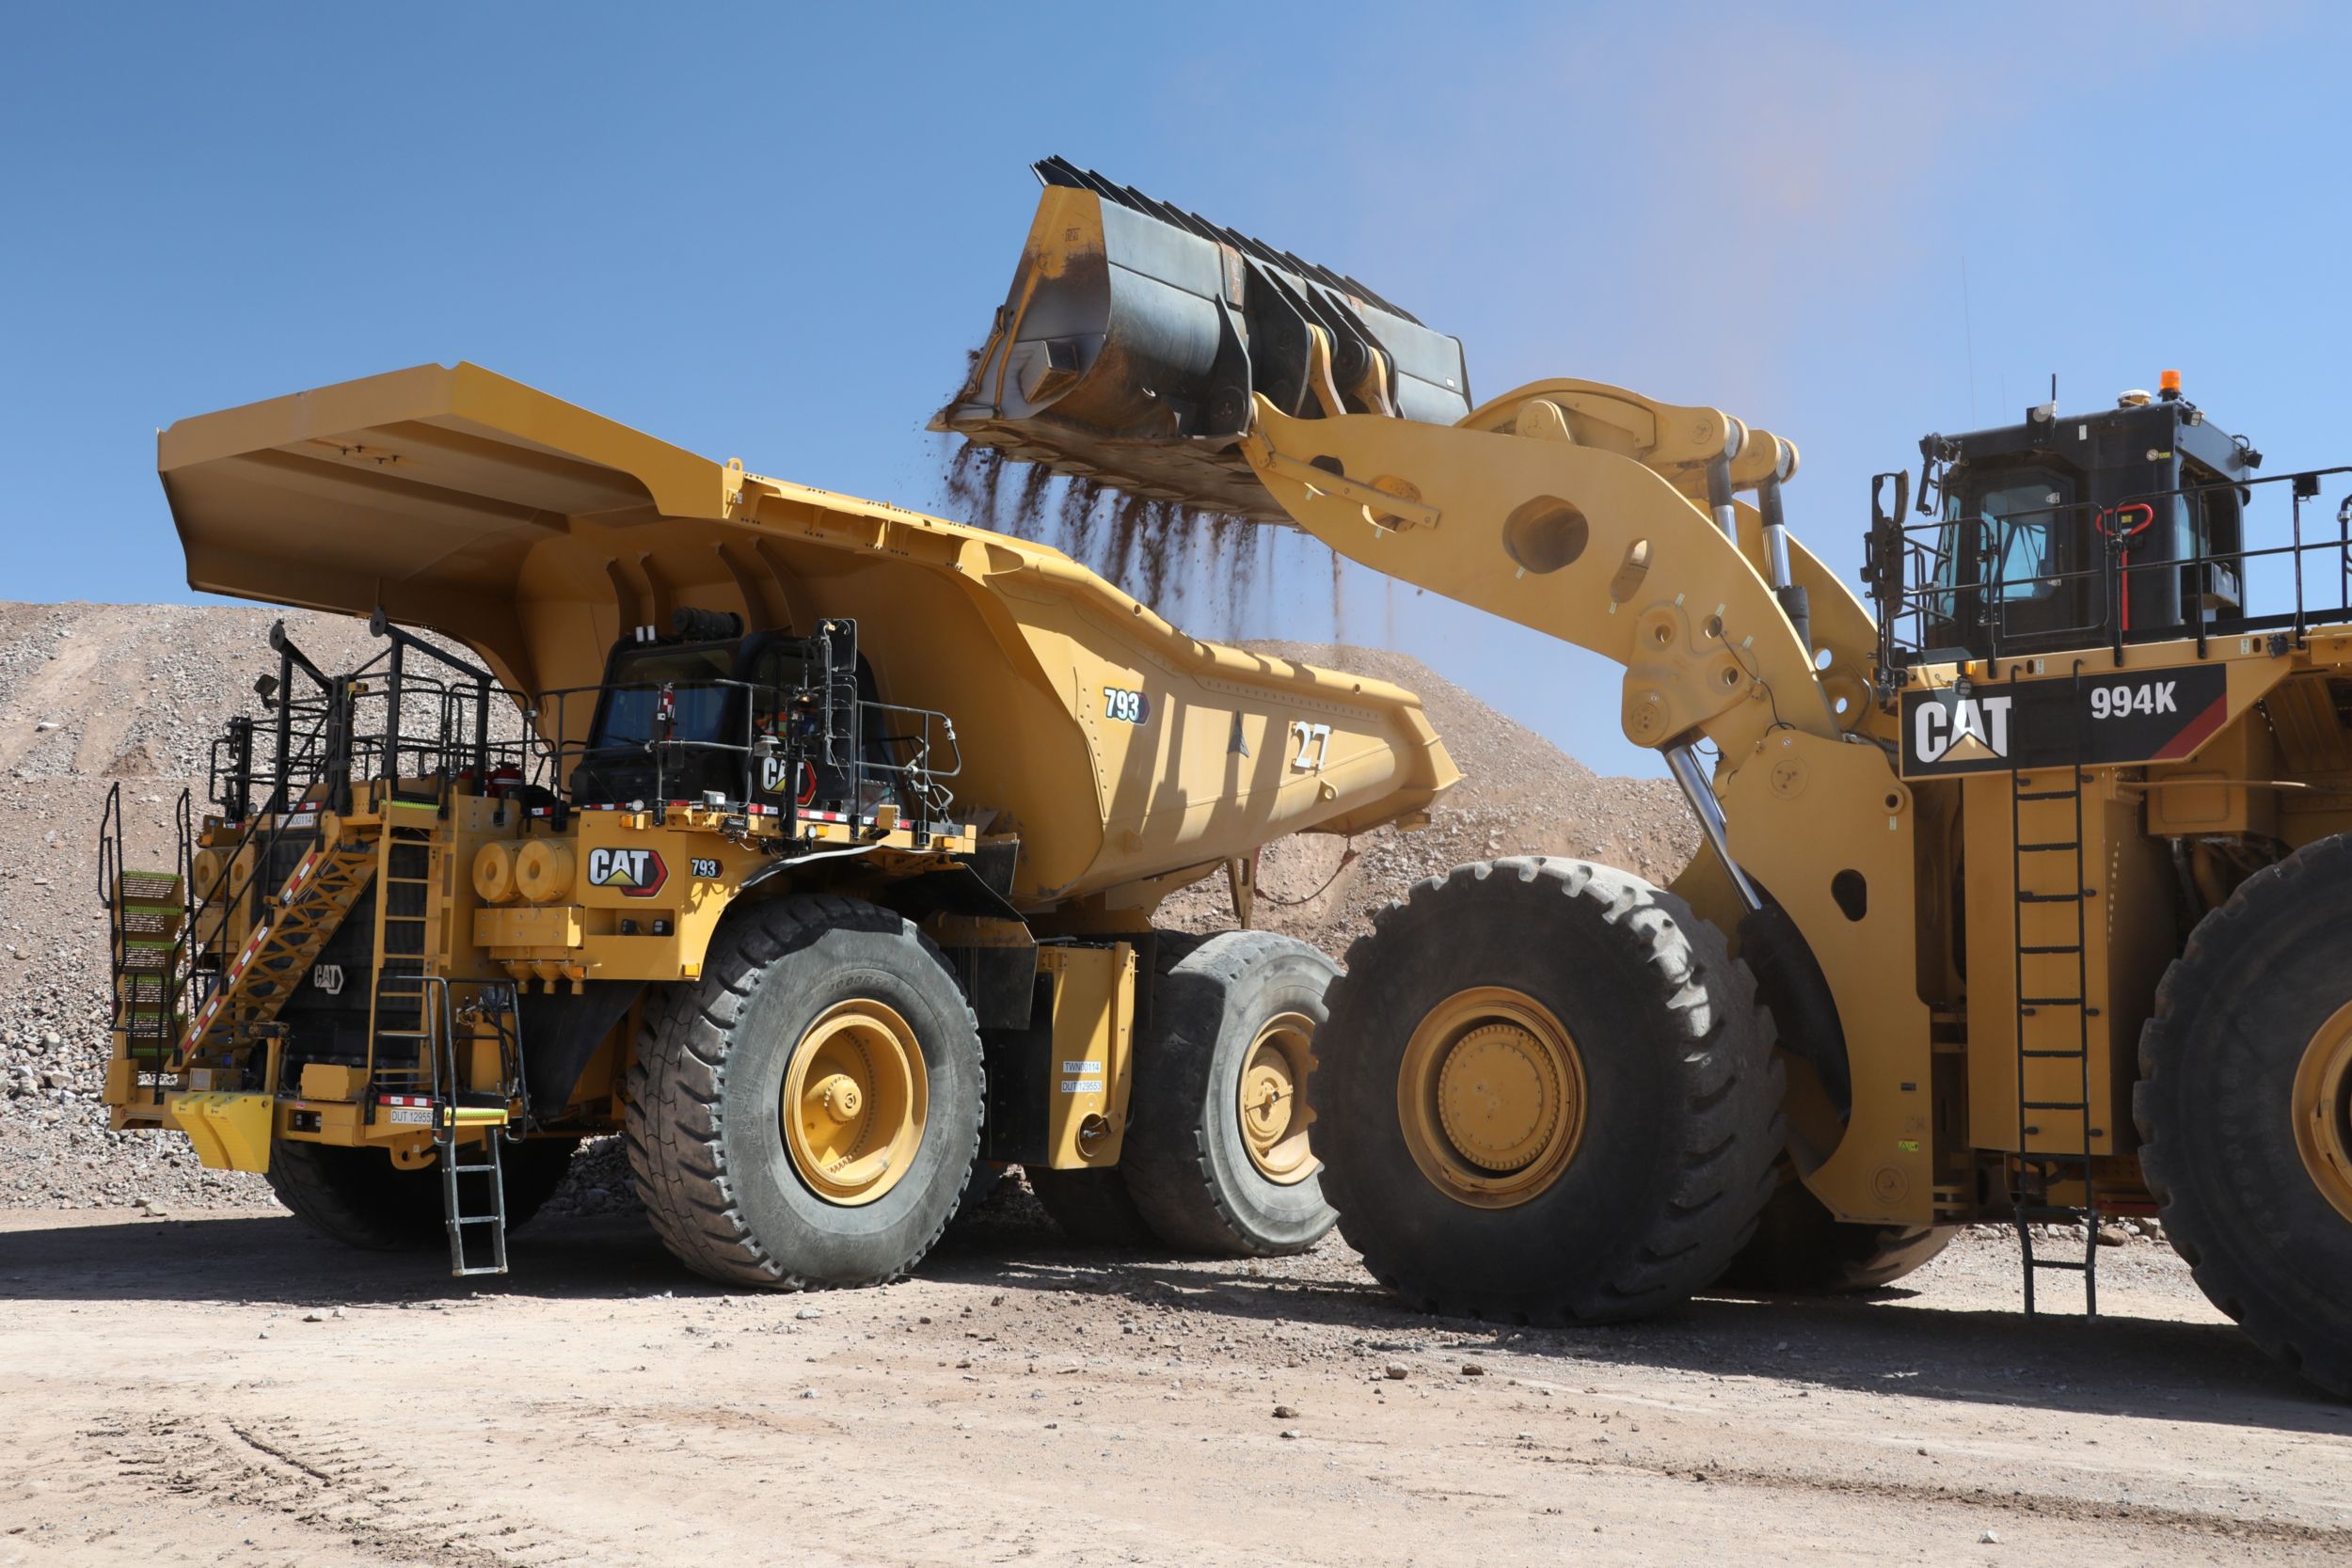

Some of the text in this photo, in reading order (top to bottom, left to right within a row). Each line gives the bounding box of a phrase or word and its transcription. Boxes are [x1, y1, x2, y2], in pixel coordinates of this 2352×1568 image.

[1104, 687, 1140, 721] 793
[2090, 680, 2177, 720] 994K
[1915, 695, 2012, 764] CAT
[1294, 721, 1331, 770] 27
[590, 848, 649, 886] CAT
[691, 859, 717, 877] 793
[314, 964, 340, 990] CAT
[1064, 1062, 1100, 1071] TWN00114
[1062, 1082, 1077, 1091] DUT
[391, 1111, 434, 1122] DUT 12955
